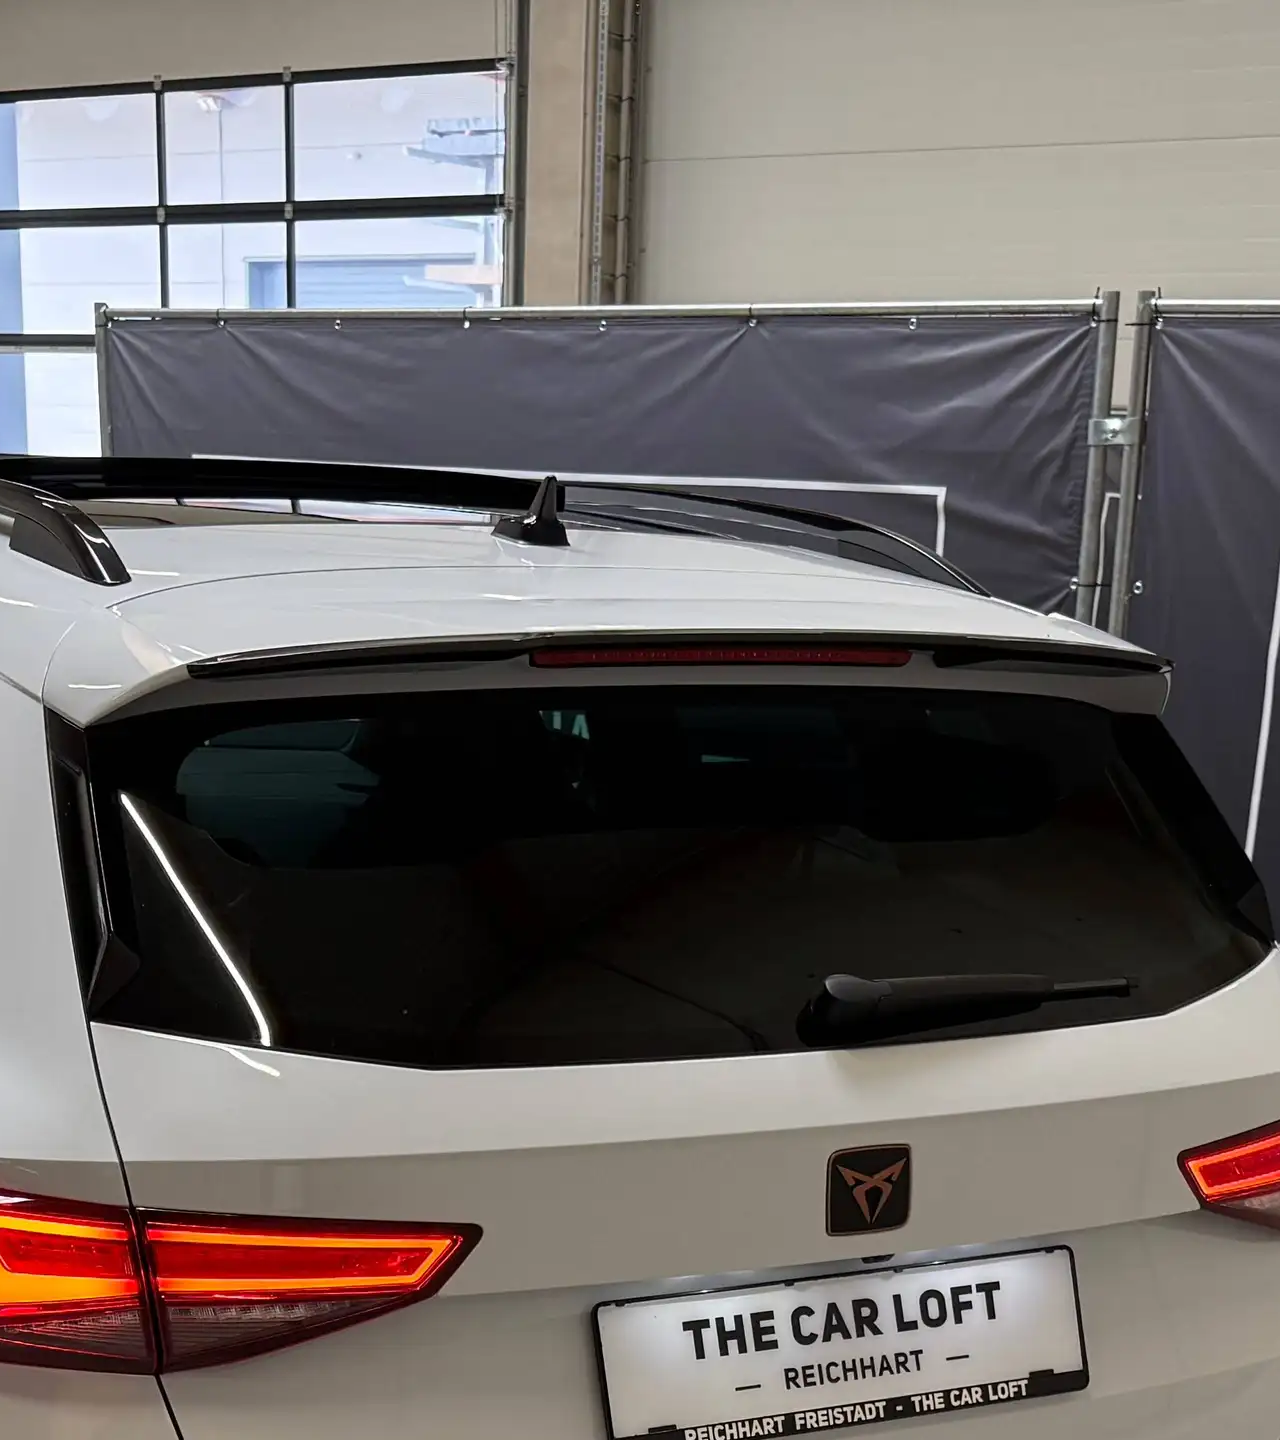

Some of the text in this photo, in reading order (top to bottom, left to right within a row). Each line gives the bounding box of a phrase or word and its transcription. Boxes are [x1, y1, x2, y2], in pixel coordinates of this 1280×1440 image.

[681, 1280, 1001, 1361] THE CAR LOFT
[783, 1349, 924, 1391] REICHHART
[794, 1400, 887, 1431] FREISTADT
[910, 1392, 945, 1413] THE
[949, 1386, 984, 1407] CAR
[987, 1379, 1029, 1401] LOFT
